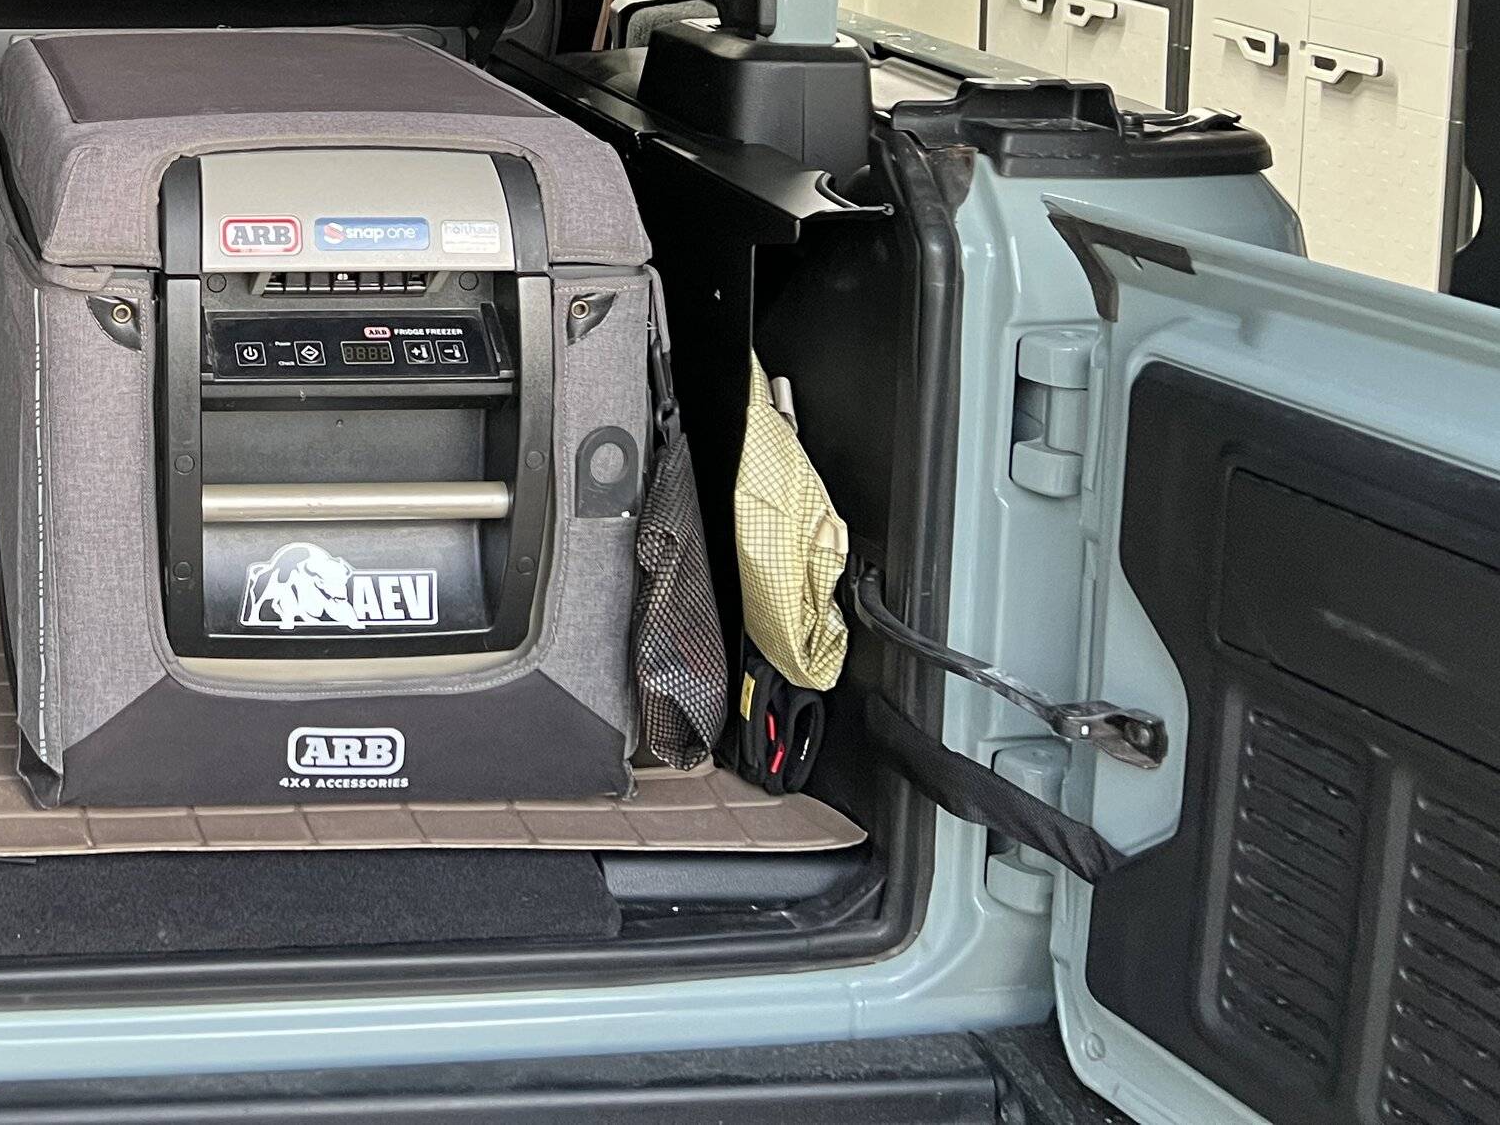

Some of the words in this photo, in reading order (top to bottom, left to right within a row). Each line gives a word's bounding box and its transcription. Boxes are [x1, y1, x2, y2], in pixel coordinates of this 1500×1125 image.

[231, 225, 293, 246] ARB
[346, 224, 383, 242] snap
[387, 227, 416, 240] one
[394, 328, 425, 336] FRIDGE
[352, 575, 431, 620] AEV
[300, 736, 394, 767] ARB
[279, 777, 311, 789] 4X4
[315, 777, 410, 789] ACCESSORIES
